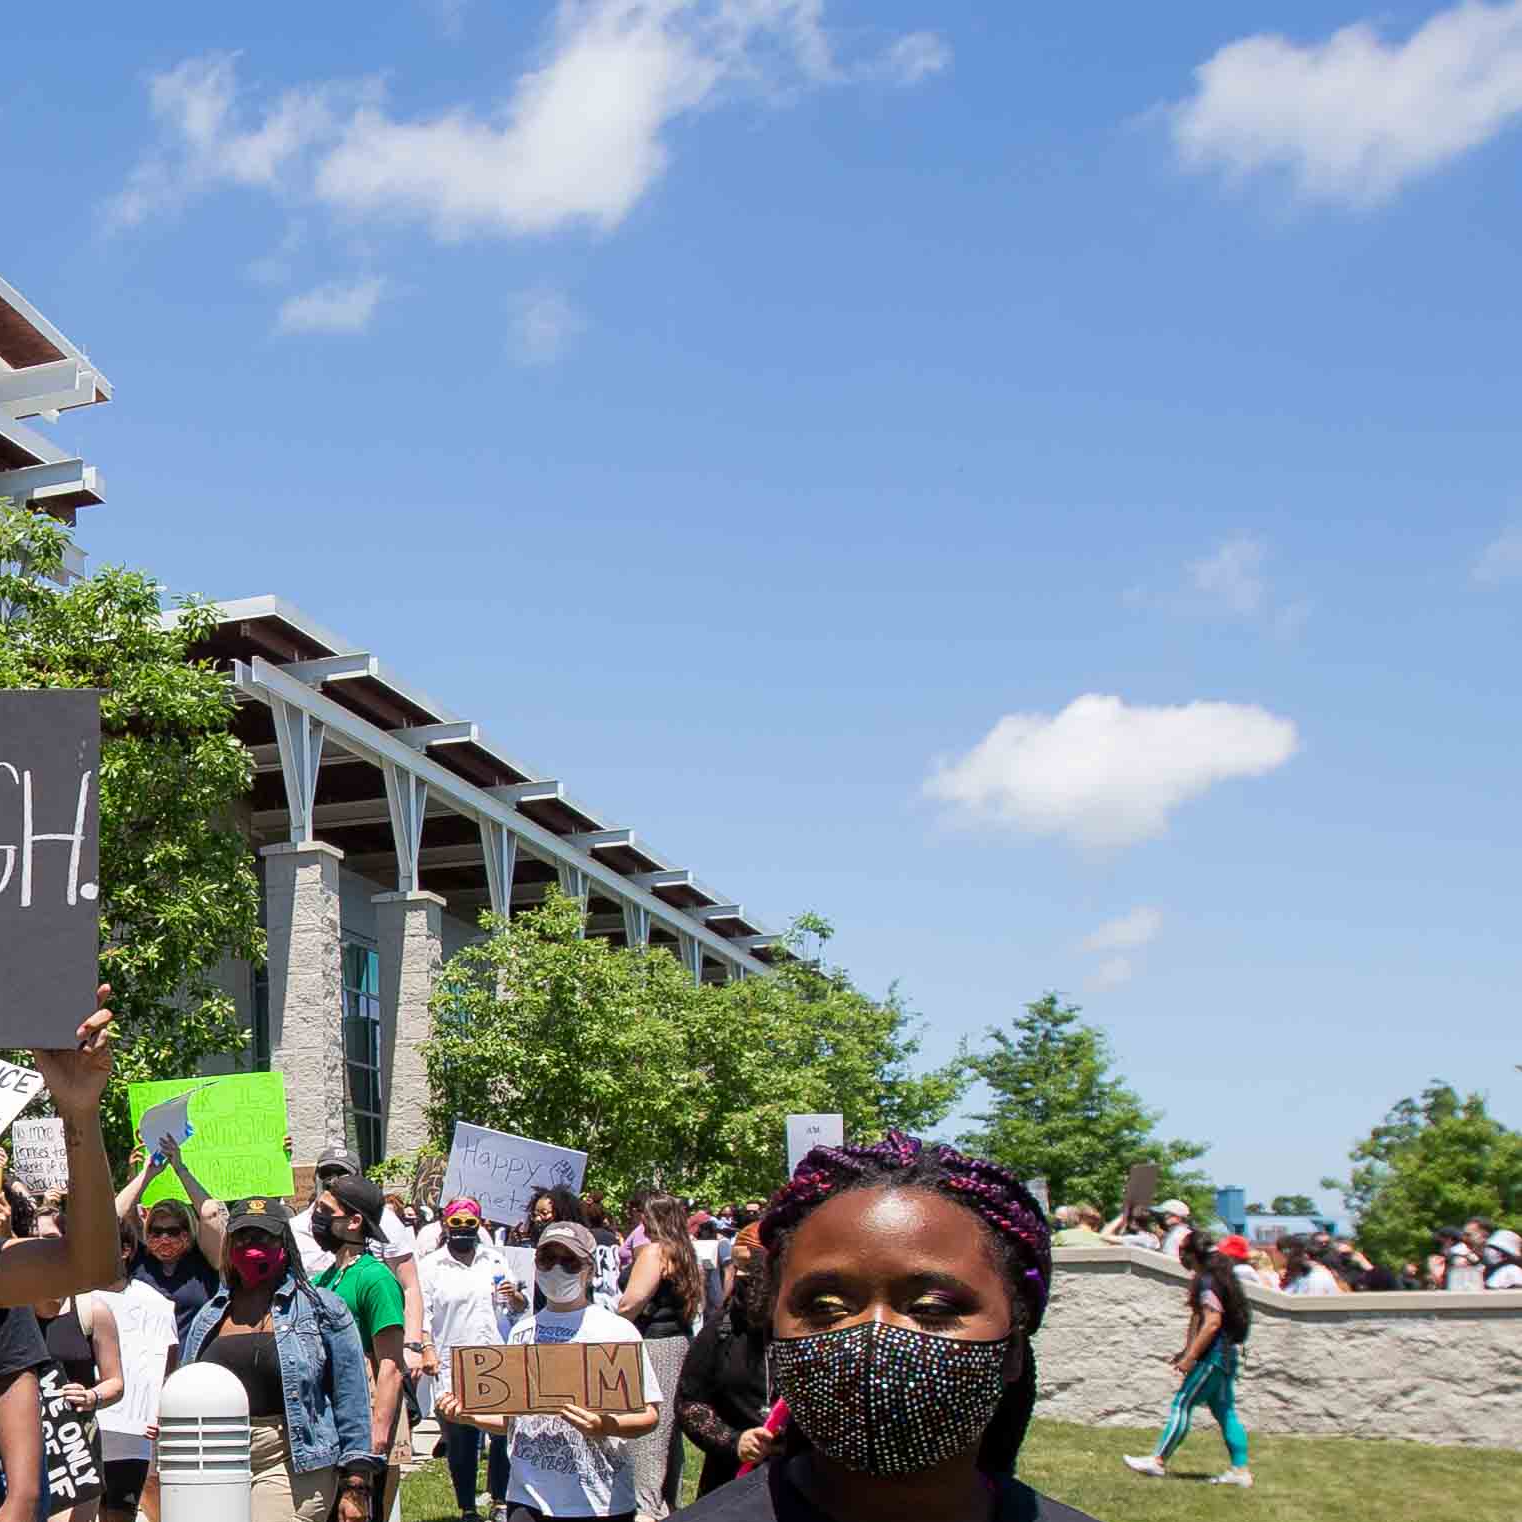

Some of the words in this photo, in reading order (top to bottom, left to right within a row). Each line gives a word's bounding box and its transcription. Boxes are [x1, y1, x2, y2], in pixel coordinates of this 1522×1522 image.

[463, 1135, 543, 1186] Happy
[460, 1347, 644, 1410] BLM
[40, 1369, 64, 1417] WE
[58, 1421, 100, 1486] ONLY
[48, 1465, 76, 1498] IF
